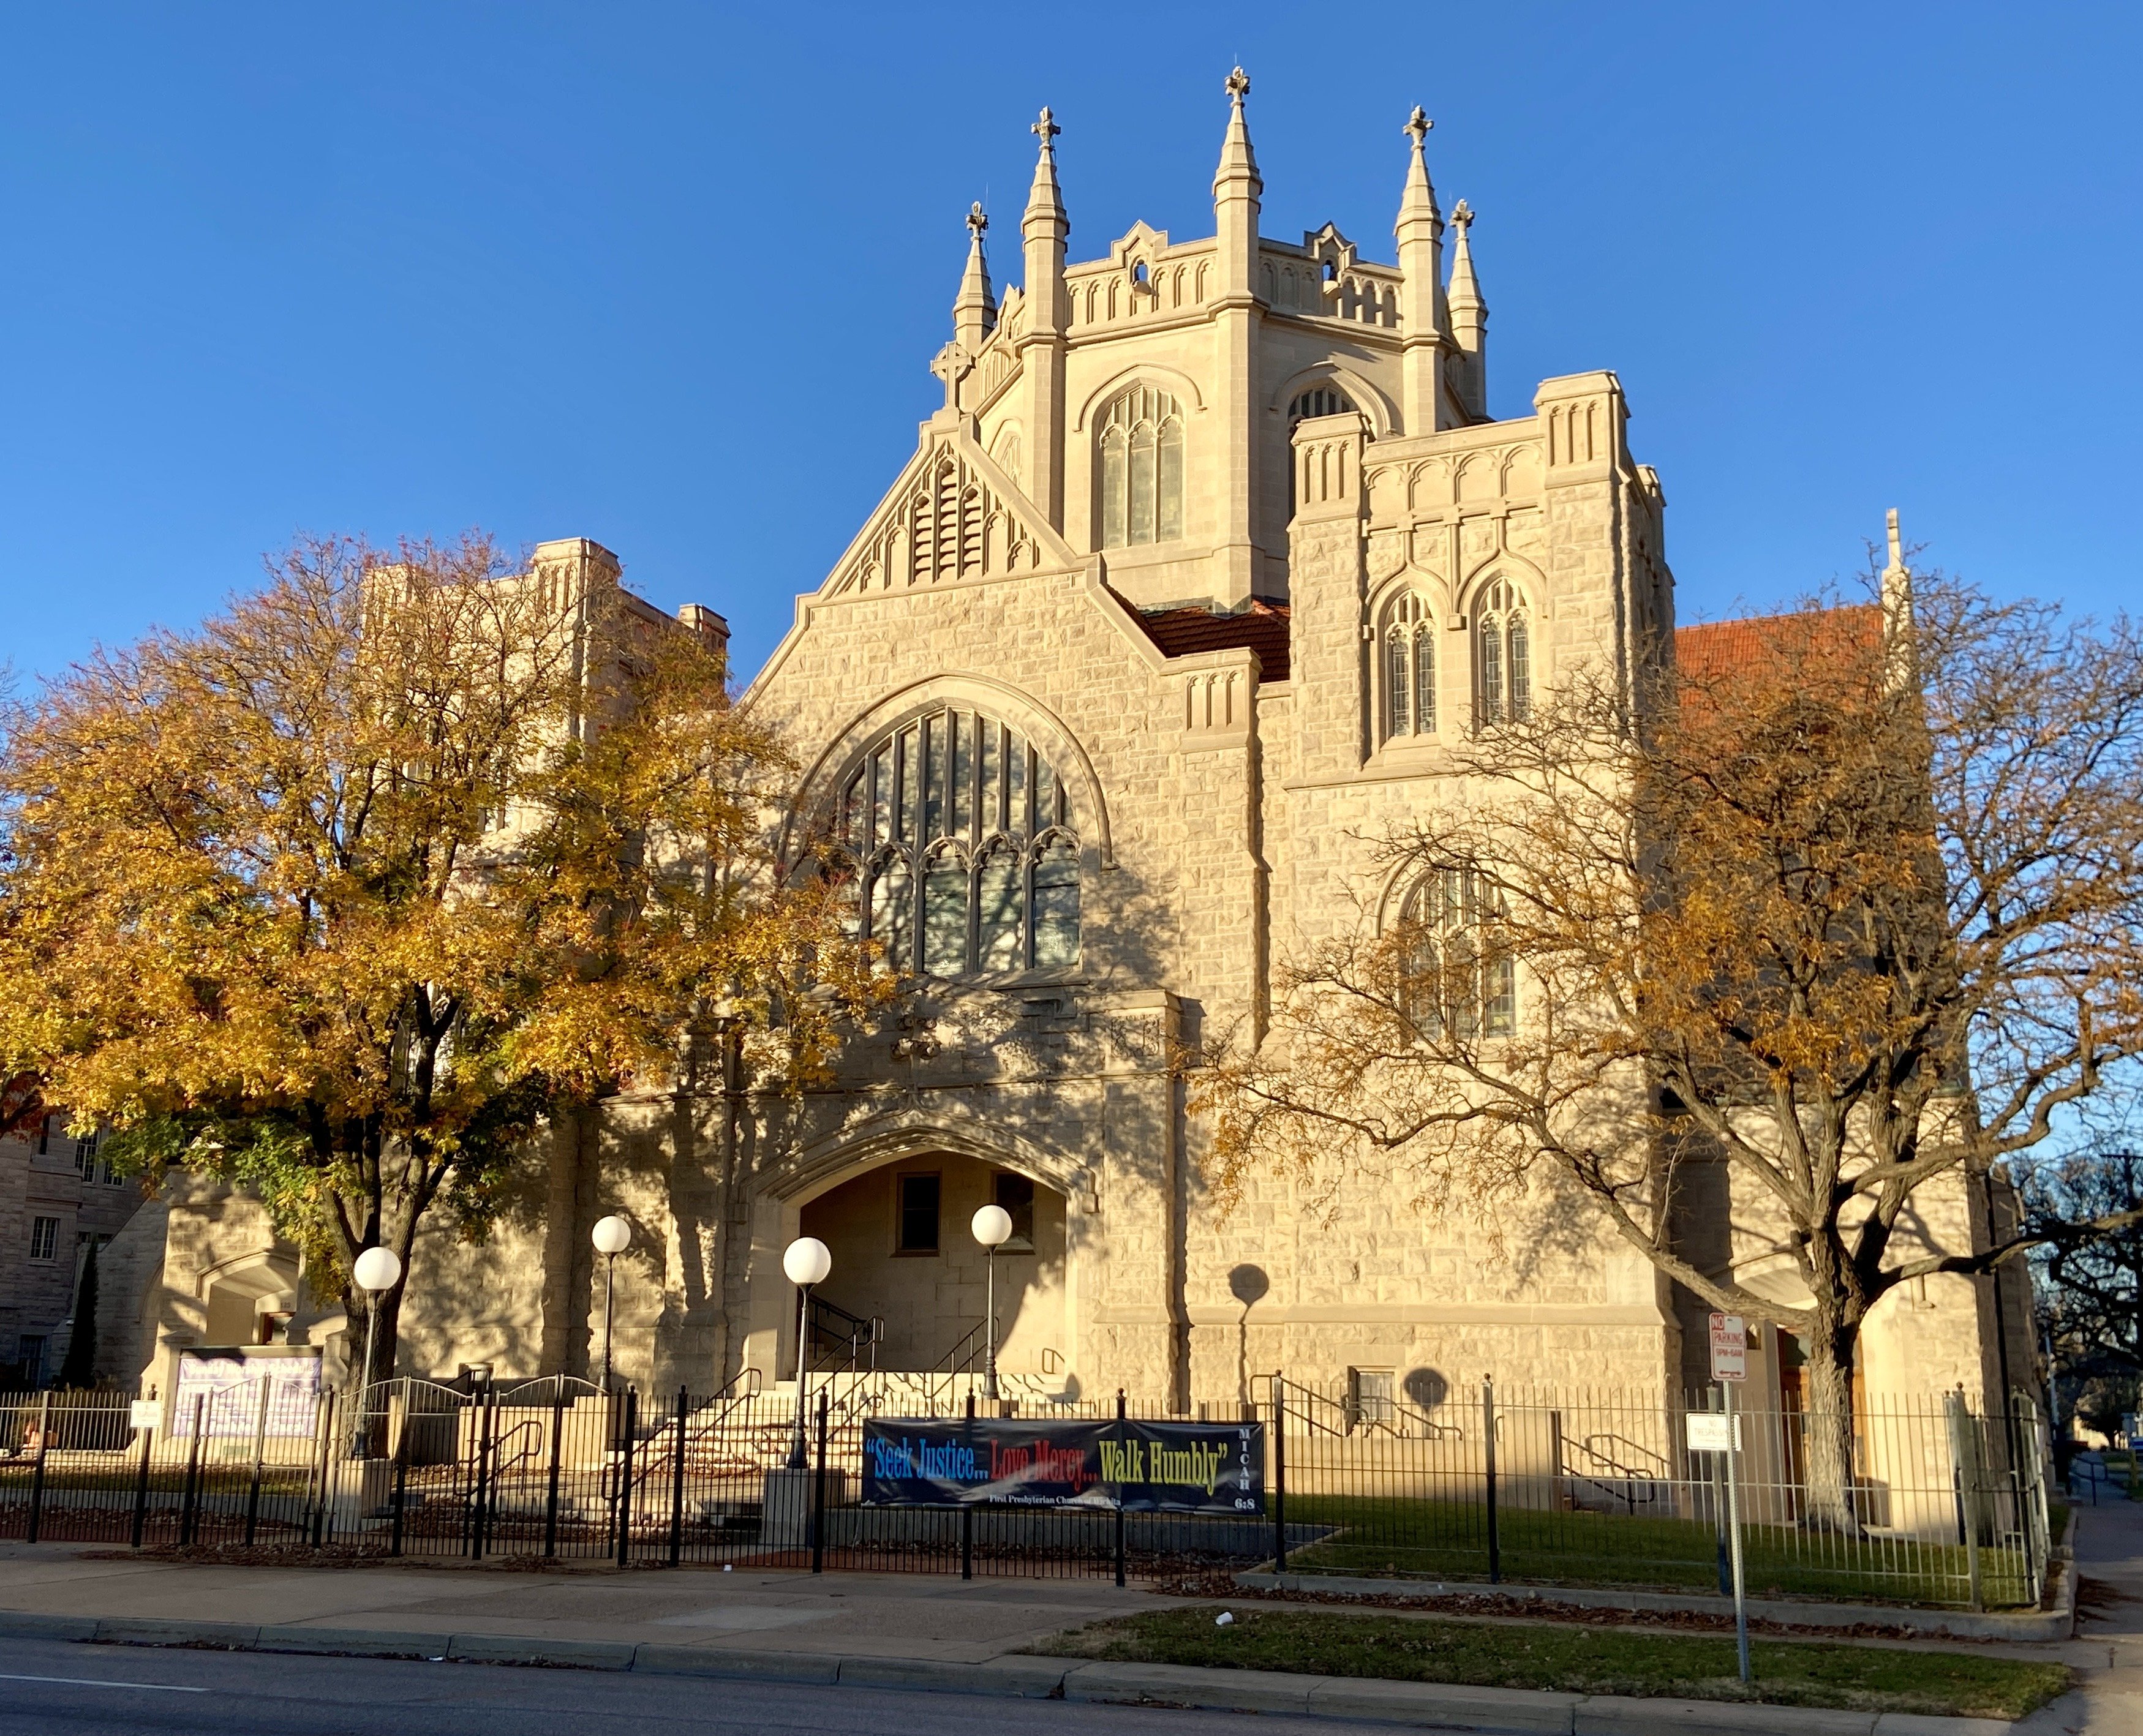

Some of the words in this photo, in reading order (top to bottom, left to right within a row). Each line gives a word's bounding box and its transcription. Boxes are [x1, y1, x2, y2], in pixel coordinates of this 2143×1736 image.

[1712, 1316, 1723, 1329] NO
[1714, 1332, 1742, 1344] PARKING
[189, 1363, 225, 1377] Sunday
[226, 1362, 267, 1375] Worship
[268, 1361, 315, 1374] Schedule
[1238, 1429, 1251, 1490] MICAH
[866, 1437, 913, 1478] “Seek
[917, 1438, 989, 1479] Justice...
[991, 1439, 1029, 1480] Love
[1034, 1440, 1098, 1492] Mercy...
[1099, 1439, 1144, 1483] Walk
[1149, 1441, 1228, 1497] Humbly”
[1008, 1495, 1055, 1505] Presbyterian
[1056, 1496, 1083, 1505] Church
[1234, 1498, 1255, 1509] 6:8
